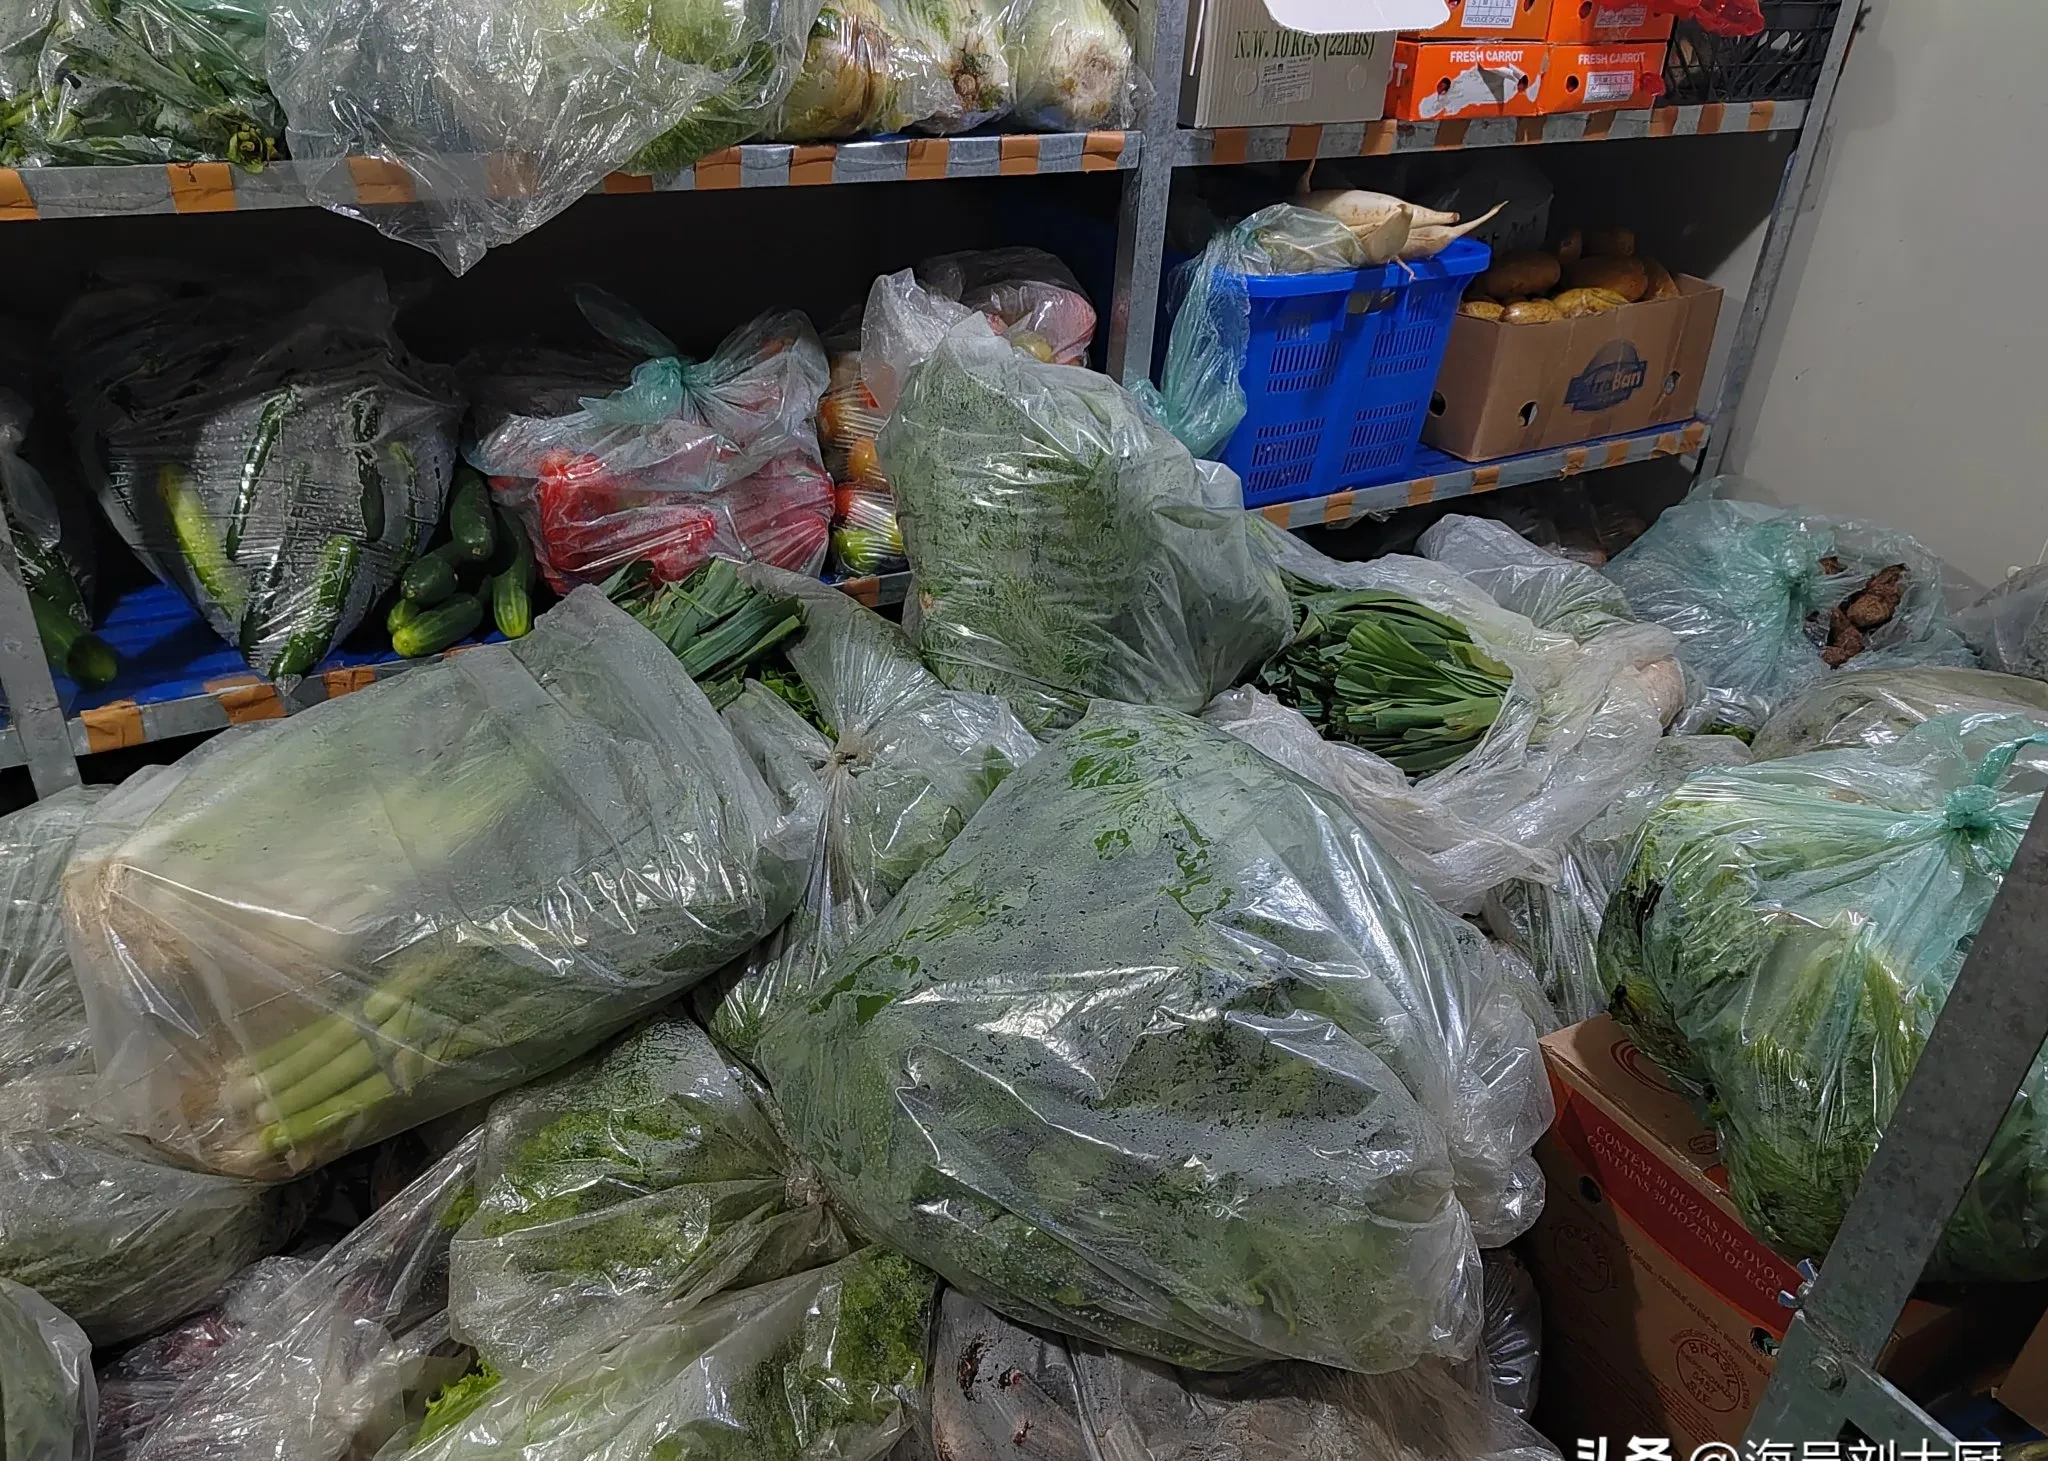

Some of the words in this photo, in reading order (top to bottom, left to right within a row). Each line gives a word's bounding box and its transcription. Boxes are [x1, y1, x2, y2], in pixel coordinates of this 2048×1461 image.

[1234, 30, 1269, 59] N.W.
[1323, 32, 1376, 62] (22LBS)
[1450, 50, 1484, 63] FRESH
[1486, 50, 1524, 63] CARROT
[1578, 53, 1608, 65] FRESH
[1609, 51, 1646, 64] CARROT
[1587, 1135, 1651, 1192] CONTAINS
[1668, 1202, 1722, 1254] DOZENS
[1724, 1250, 1744, 1270] OF
[1745, 1268, 1778, 1301] EGG
[1722, 1230, 1742, 1252] DE
[1744, 1249, 1783, 1288] OVOS
[1688, 1341, 1739, 1388] BRASIL
